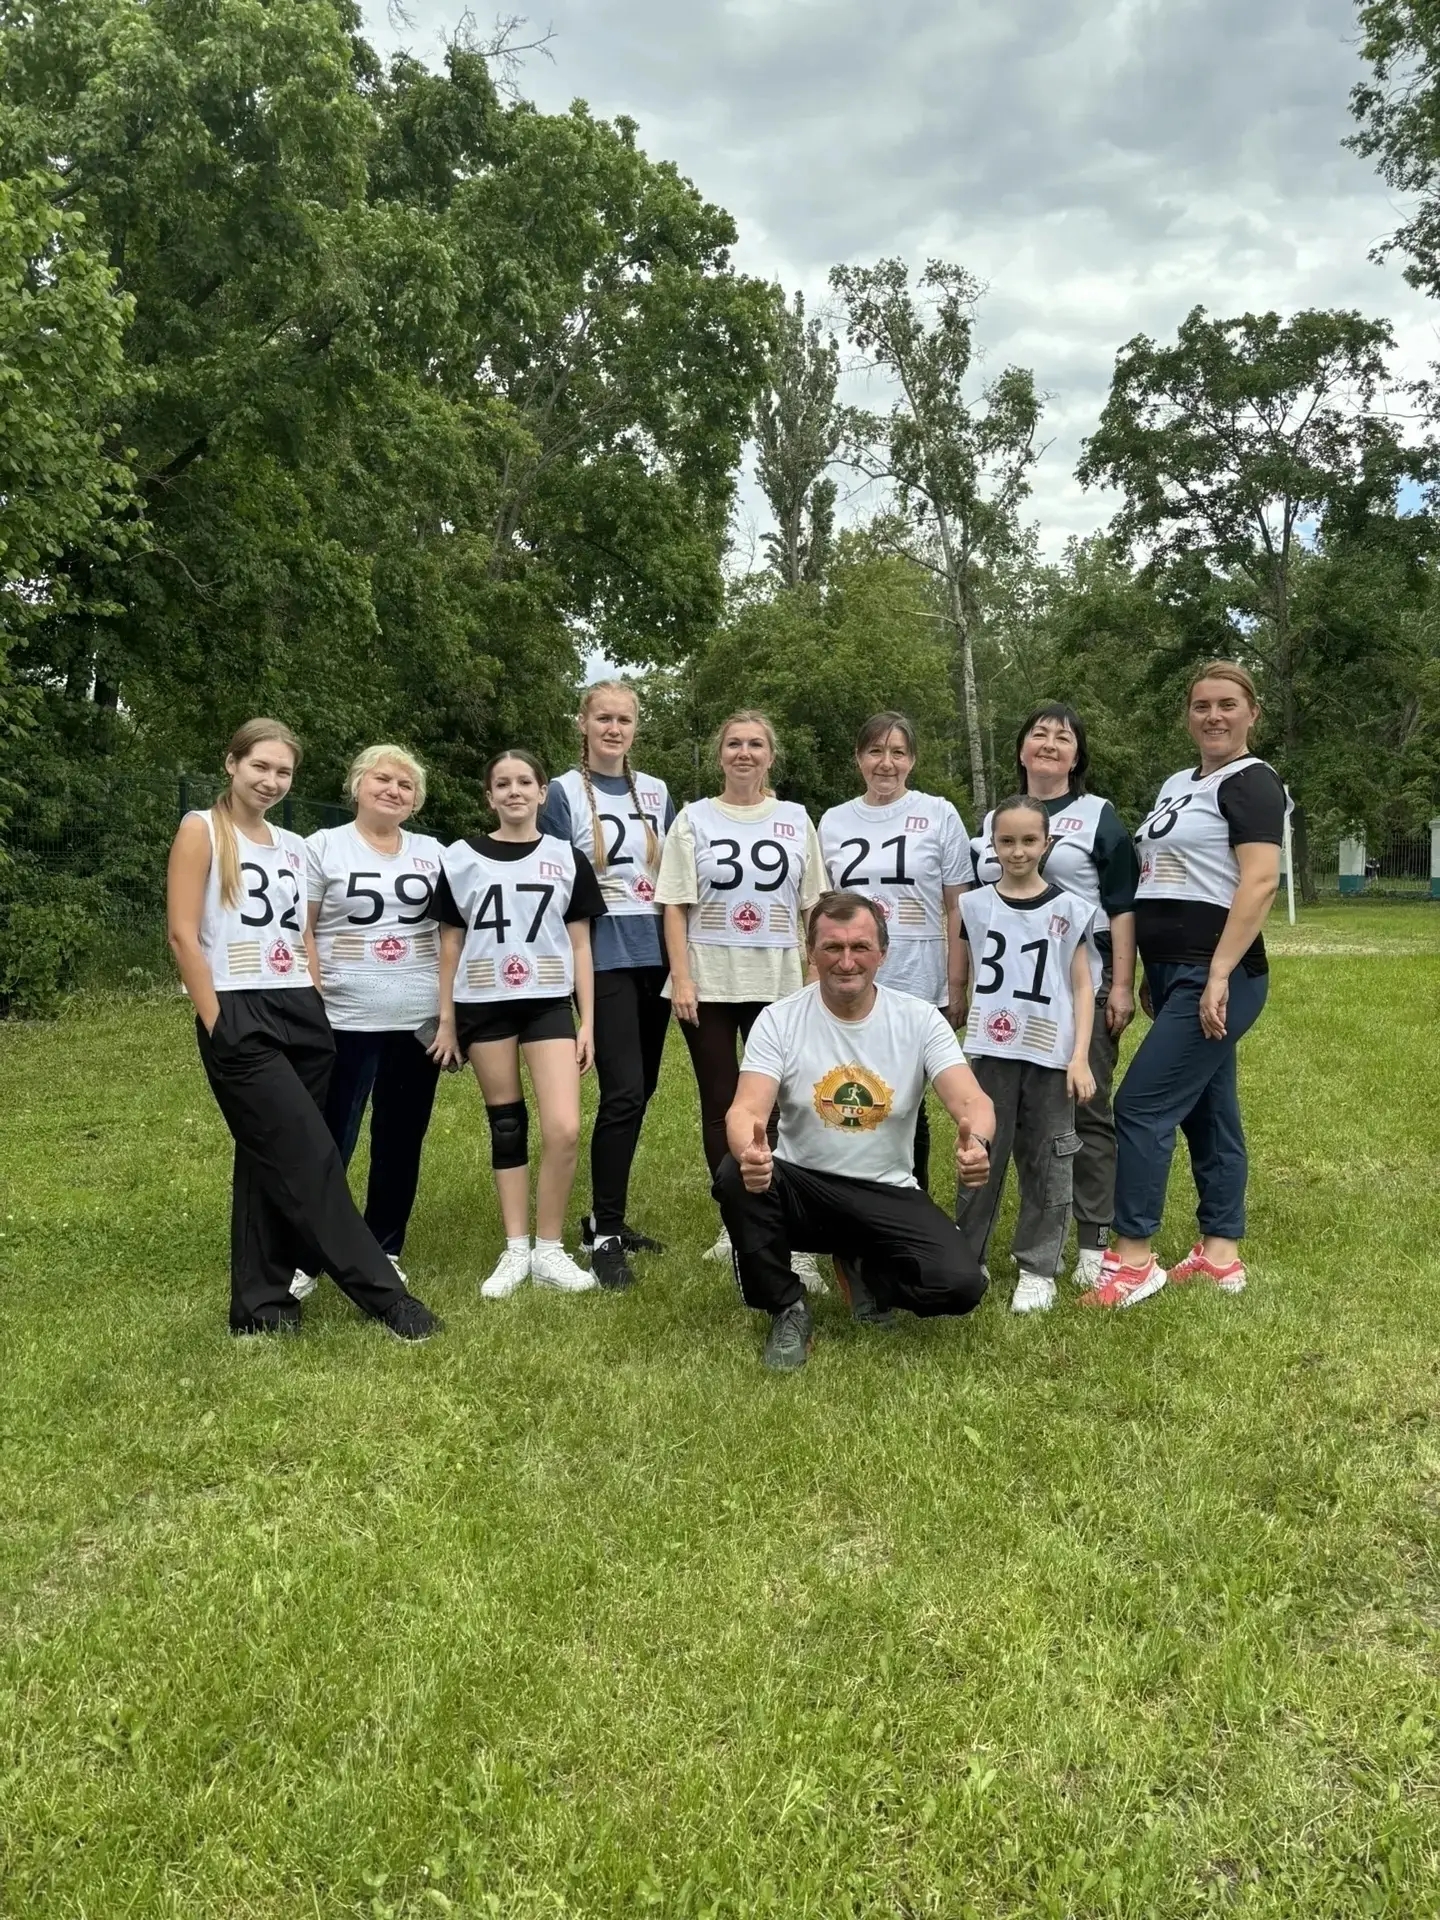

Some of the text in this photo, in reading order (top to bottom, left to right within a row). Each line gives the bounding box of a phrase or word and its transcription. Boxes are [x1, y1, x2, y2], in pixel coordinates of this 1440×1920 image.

[773, 822, 795, 836] ГТО
[905, 816, 929, 829] ГТО
[1056, 817, 1083, 831] ГТО
[413, 858, 435, 870] ГТО
[540, 862, 563, 876] ГТО
[709, 838, 789, 891] 39
[840, 835, 915, 888] 21
[240, 862, 300, 931] 32
[346, 872, 434, 925] 59
[473, 883, 555, 944] 47
[975, 929, 1051, 1005] 31
[841, 1106, 864, 1115] ГТО
